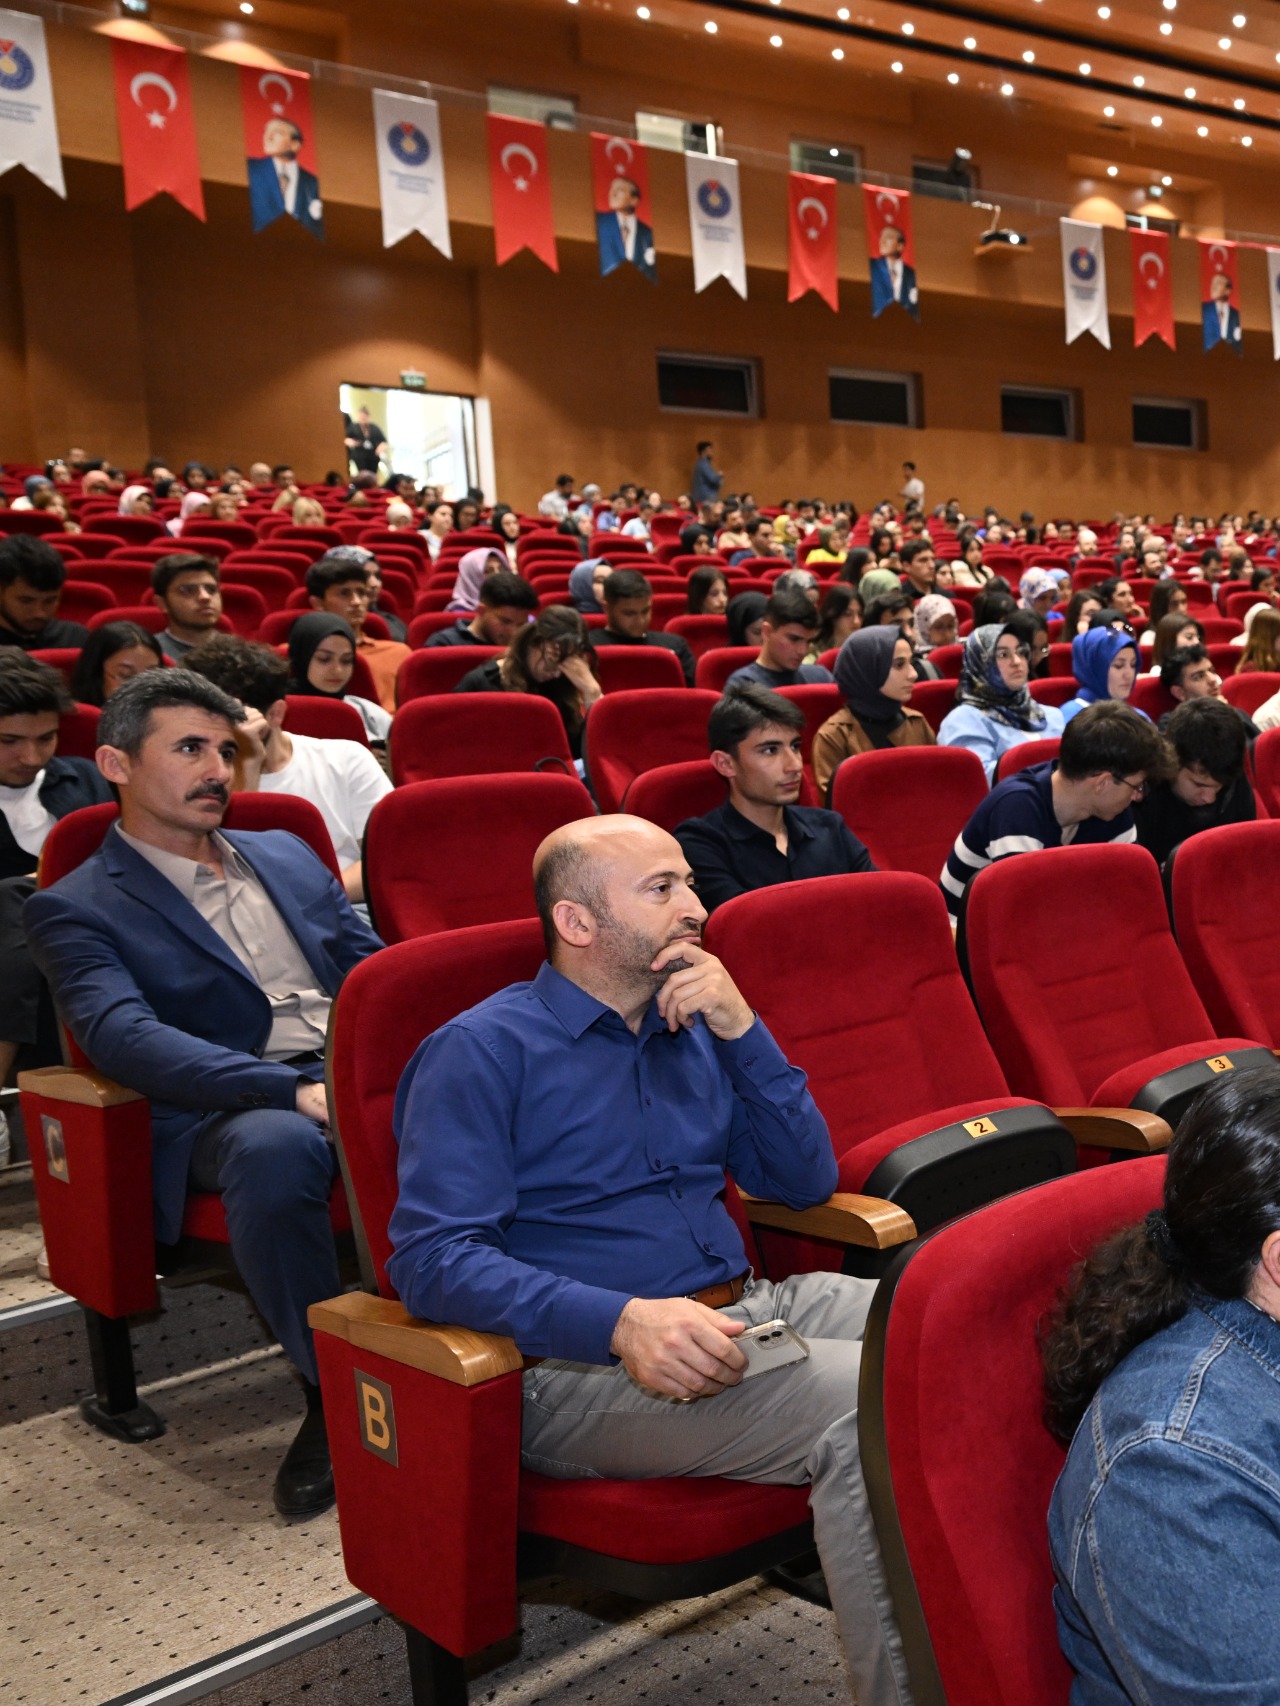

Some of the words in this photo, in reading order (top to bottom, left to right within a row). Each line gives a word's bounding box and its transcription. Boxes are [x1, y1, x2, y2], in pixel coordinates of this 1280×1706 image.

[1214, 1059, 1226, 1069] 3
[973, 1121, 988, 1134] 2
[47, 1124, 64, 1173] C
[361, 1381, 391, 1450] B
